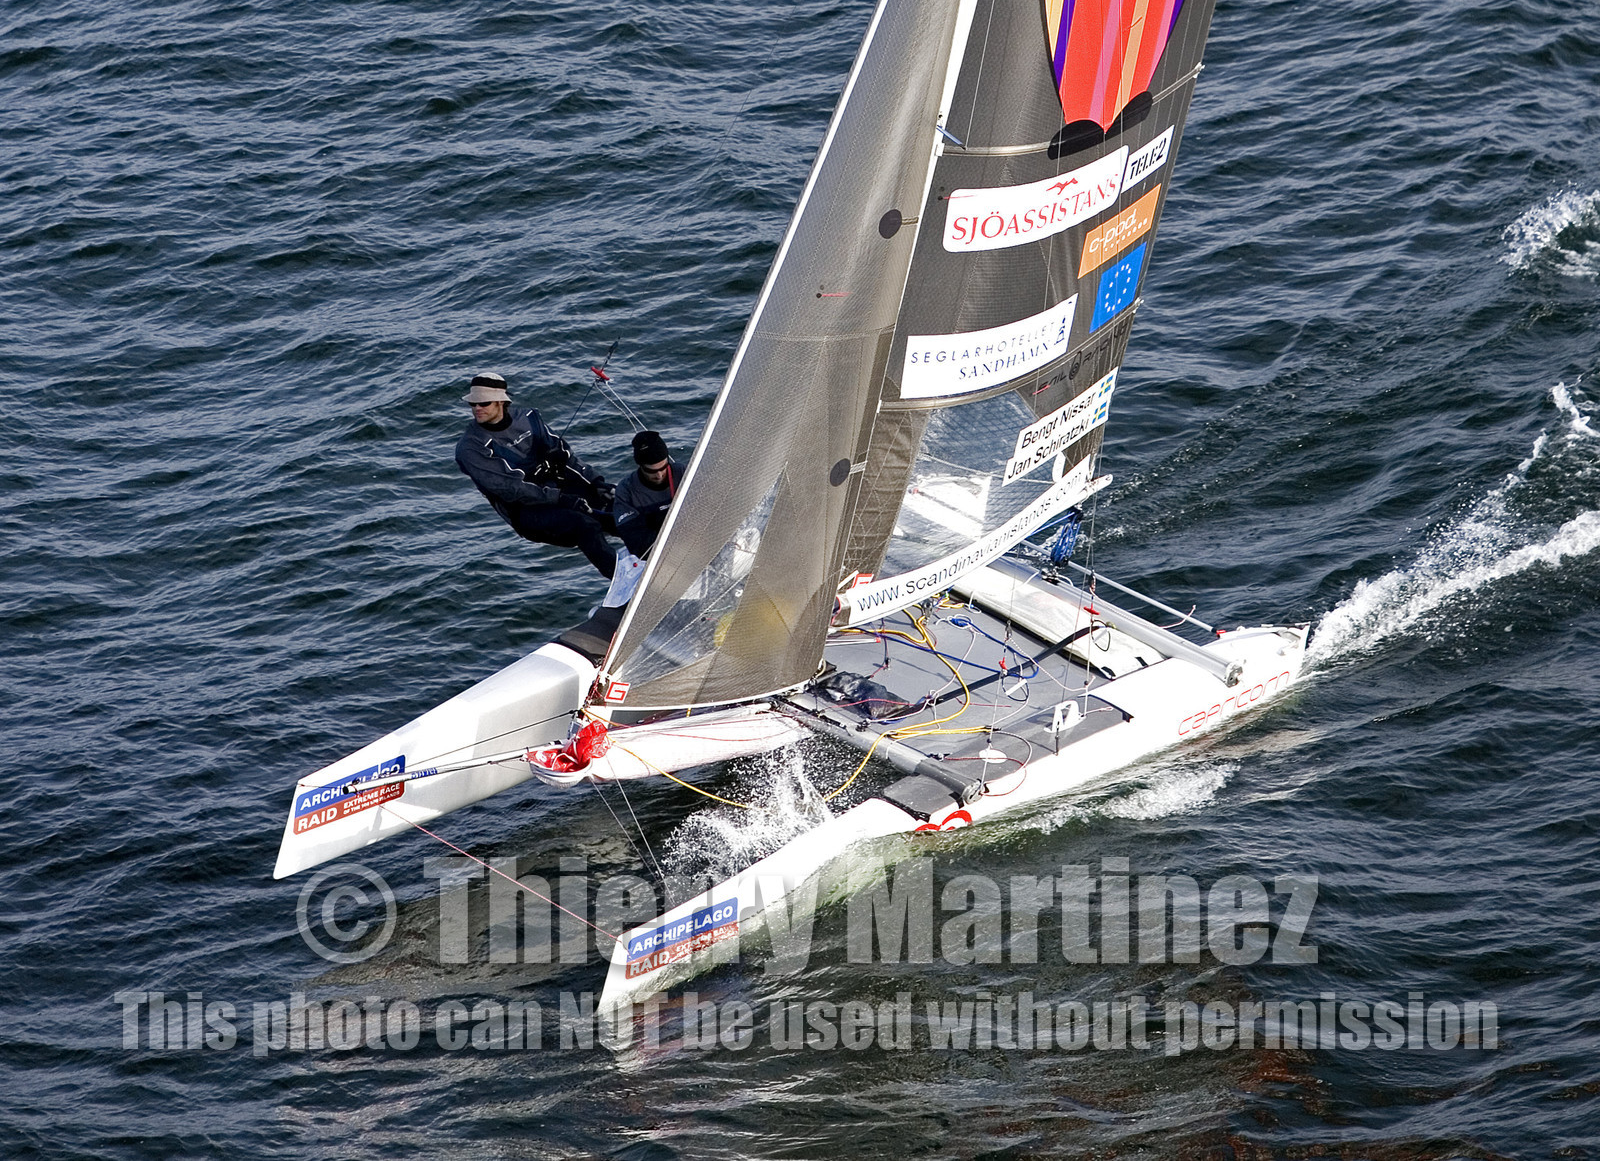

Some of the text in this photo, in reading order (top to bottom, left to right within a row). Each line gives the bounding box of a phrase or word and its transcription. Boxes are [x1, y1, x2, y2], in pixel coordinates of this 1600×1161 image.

[1130, 137, 1166, 180] TELE2
[952, 173, 1118, 245] SJÖASSISTANS
[1021, 392, 1096, 449] Bengt Nissar
[1008, 457, 1031, 479] Jan
[297, 807, 338, 832] RAID
[380, 783, 400, 799] RACE
[632, 905, 734, 955] ARCHIPELAGO
[630, 951, 670, 976] RAID
